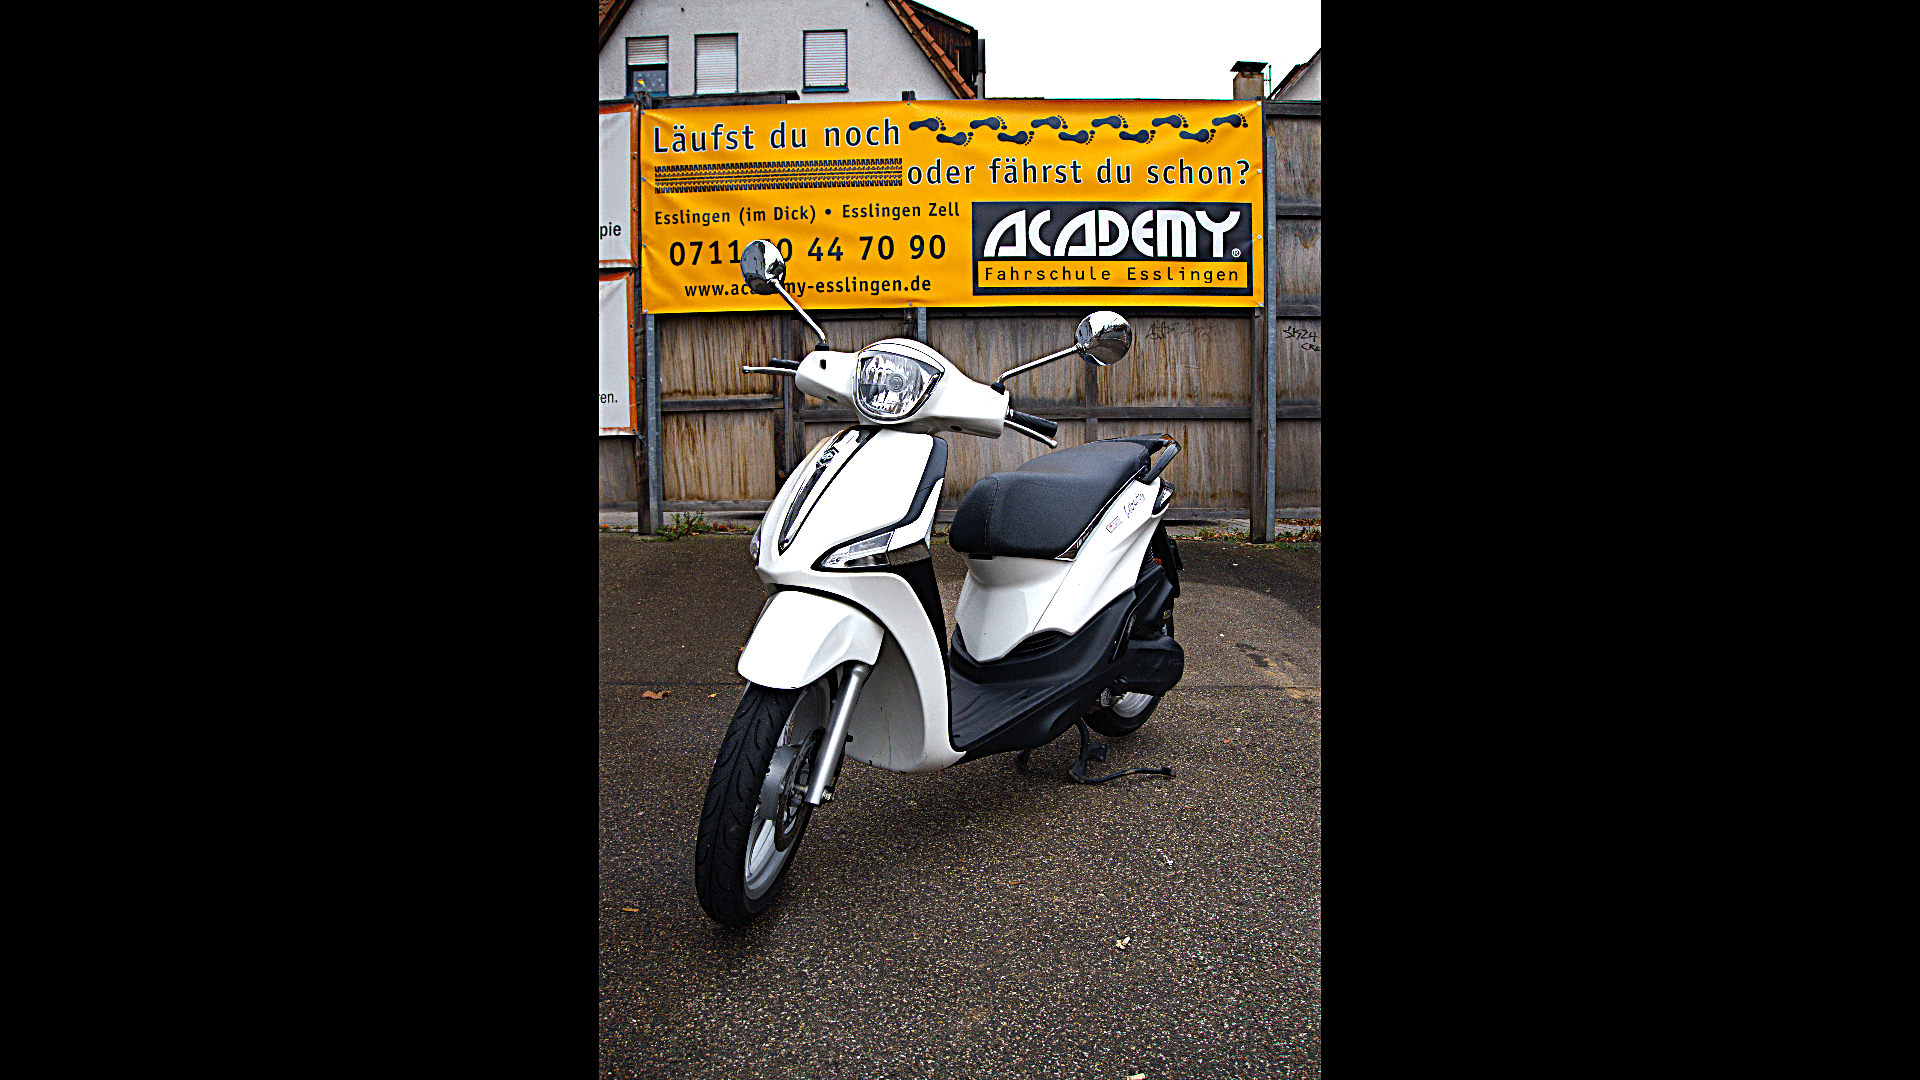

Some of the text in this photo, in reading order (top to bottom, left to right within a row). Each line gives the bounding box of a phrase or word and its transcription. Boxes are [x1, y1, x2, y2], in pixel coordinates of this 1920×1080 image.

[654, 117, 900, 153] Läufst du noch
[907, 157, 1250, 185] oder fährst du schon?
[655, 202, 960, 226] Esslingen (im Dick) Esslingen Zell
[669, 239, 741, 266] 0711
[807, 236, 843, 261] 44
[859, 235, 894, 260] 70
[909, 234, 946, 259] 90
[684, 275, 931, 297] www.acmy-esslingen.de
[985, 266, 1238, 284] Fahrschule Esslingen
